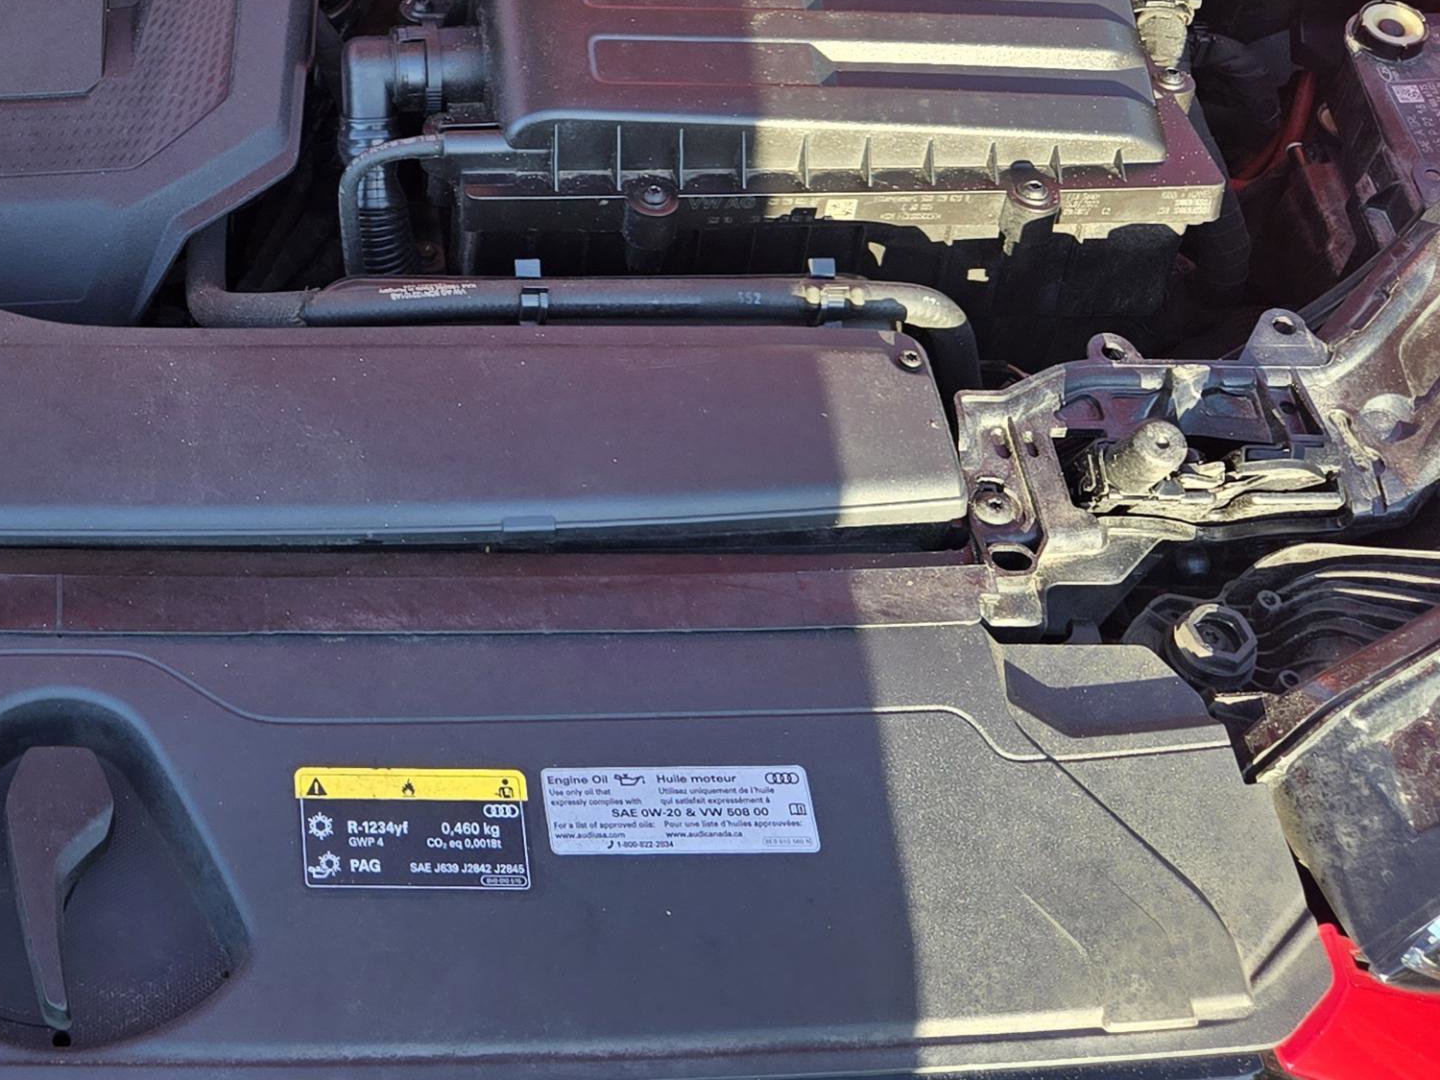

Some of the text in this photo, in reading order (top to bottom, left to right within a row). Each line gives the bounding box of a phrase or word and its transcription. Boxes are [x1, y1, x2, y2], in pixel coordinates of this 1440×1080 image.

[547, 775, 608, 786] Engine Oil
[656, 774, 736, 784] Huile moteur
[612, 808, 769, 818] SAE 0W-20 & VW 508 00
[347, 820, 408, 837] R-1234yf
[441, 822, 500, 838] 0,460 kg
[349, 837, 384, 847] GWP 4
[449, 840, 463, 850] eq
[350, 859, 381, 873] PAG
[410, 862, 525, 873] SAE J639 J2842 J2845
